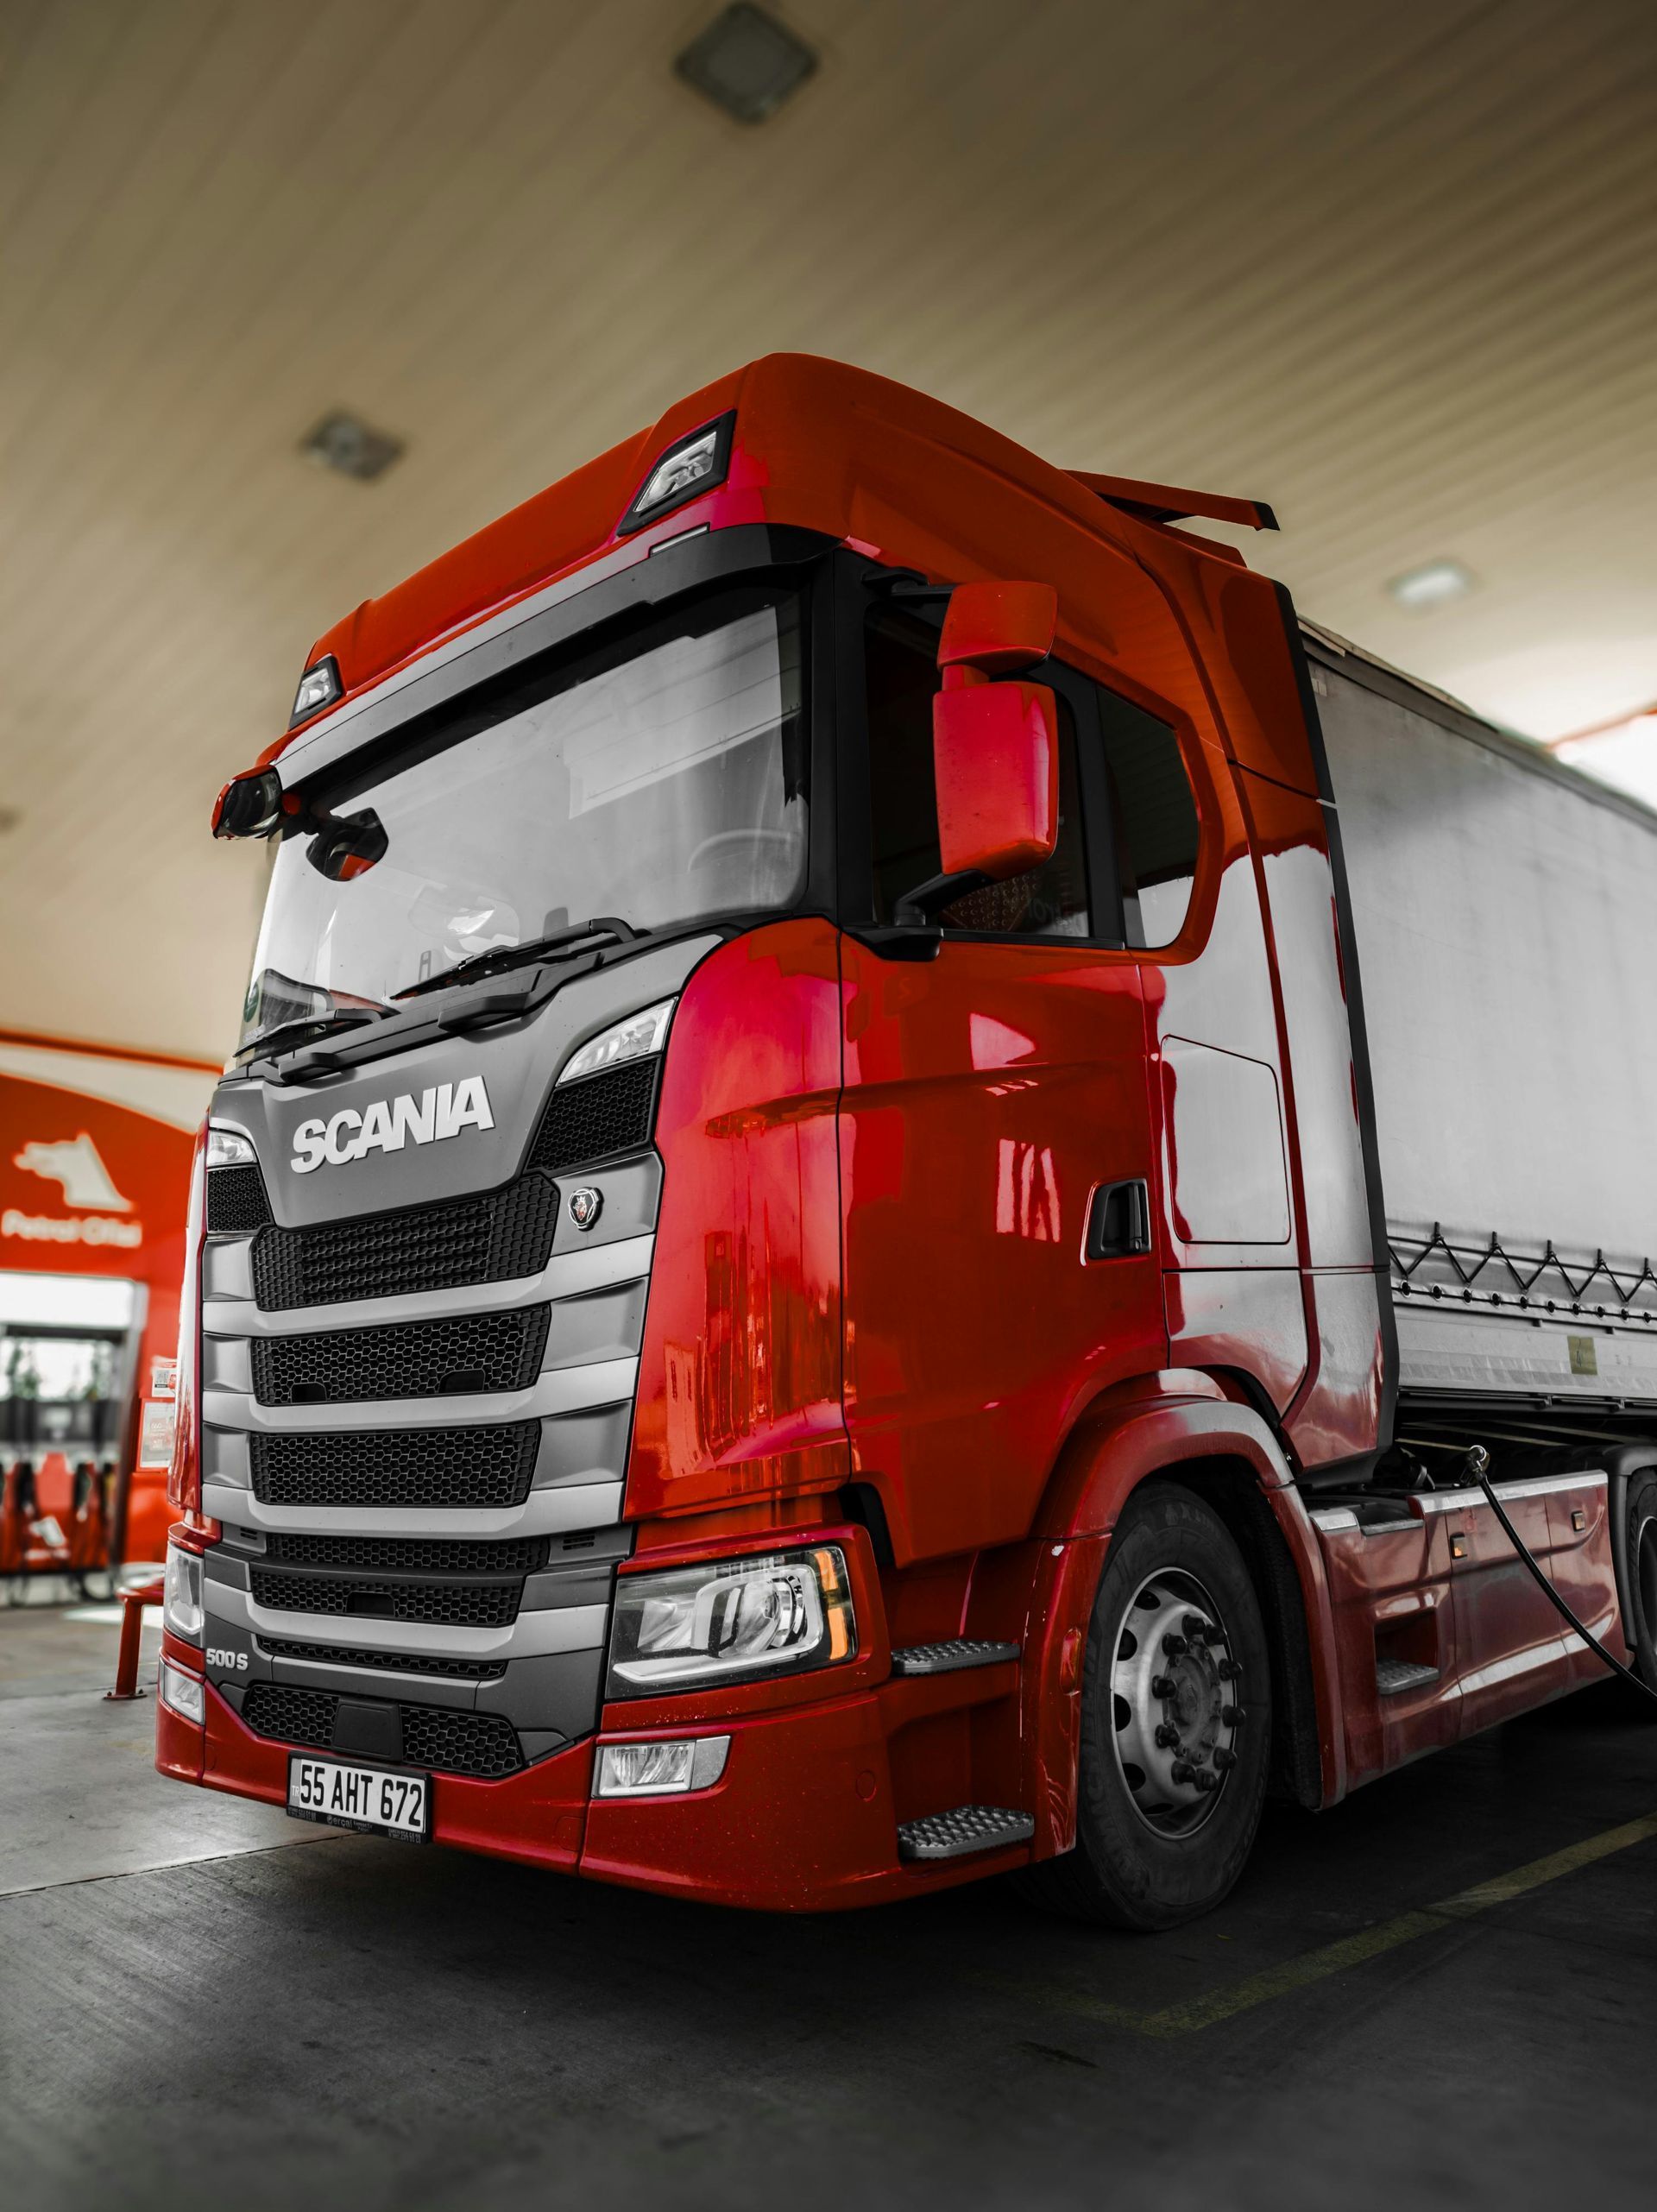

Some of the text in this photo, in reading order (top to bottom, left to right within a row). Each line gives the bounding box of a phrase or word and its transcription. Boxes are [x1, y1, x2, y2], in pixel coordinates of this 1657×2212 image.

[291, 1075, 495, 1174] SCANIA
[206, 1648, 249, 1671] 500 S
[292, 1785, 299, 1798] TR
[300, 1764, 423, 1827] 55 AHT 672
